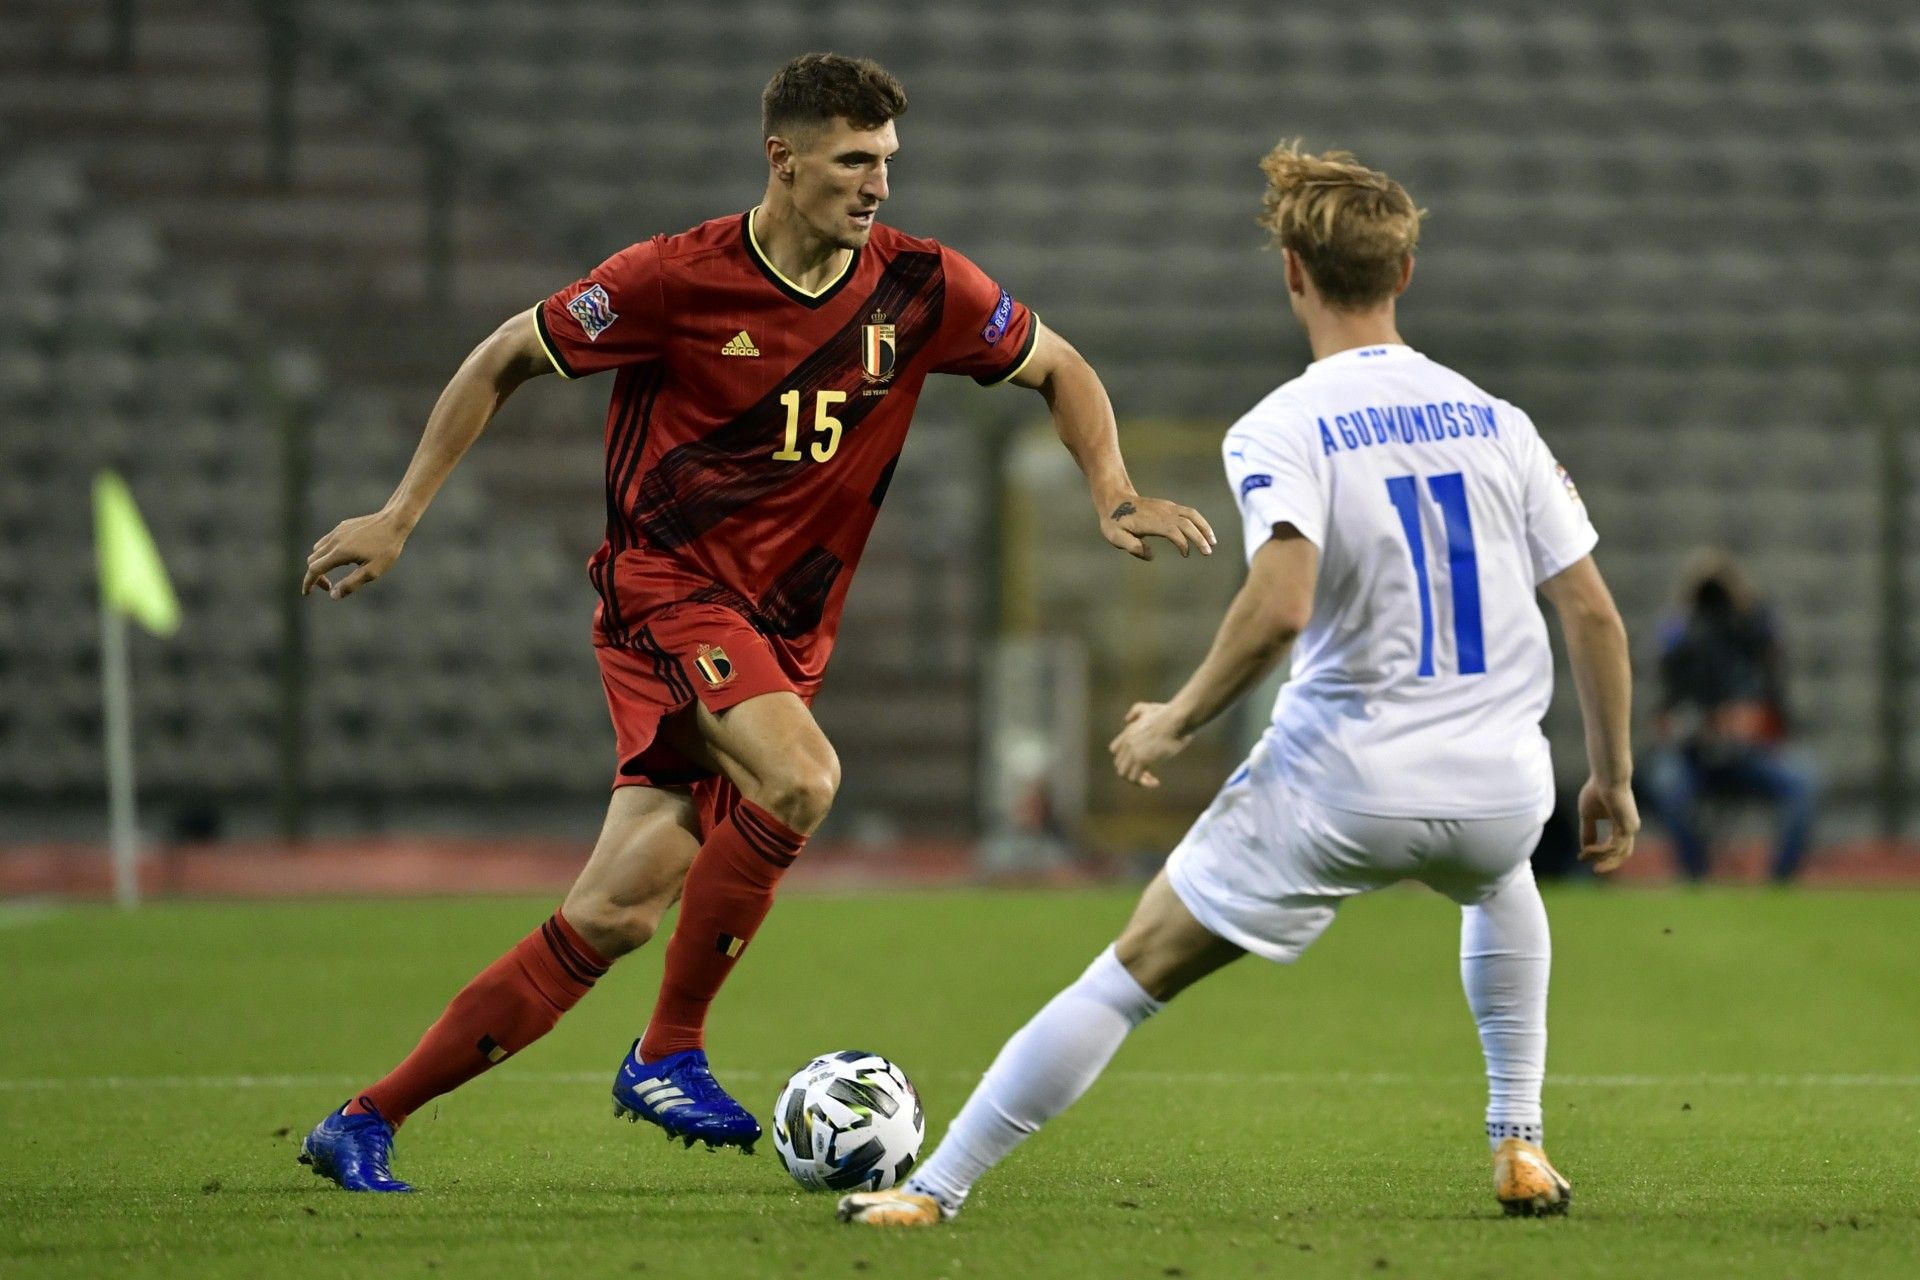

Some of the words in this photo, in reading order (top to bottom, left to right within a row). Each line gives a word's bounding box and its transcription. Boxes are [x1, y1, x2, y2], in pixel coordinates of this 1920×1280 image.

[721, 347, 760, 357] adidas
[772, 390, 847, 463] 15
[1385, 471, 1487, 677] 11
